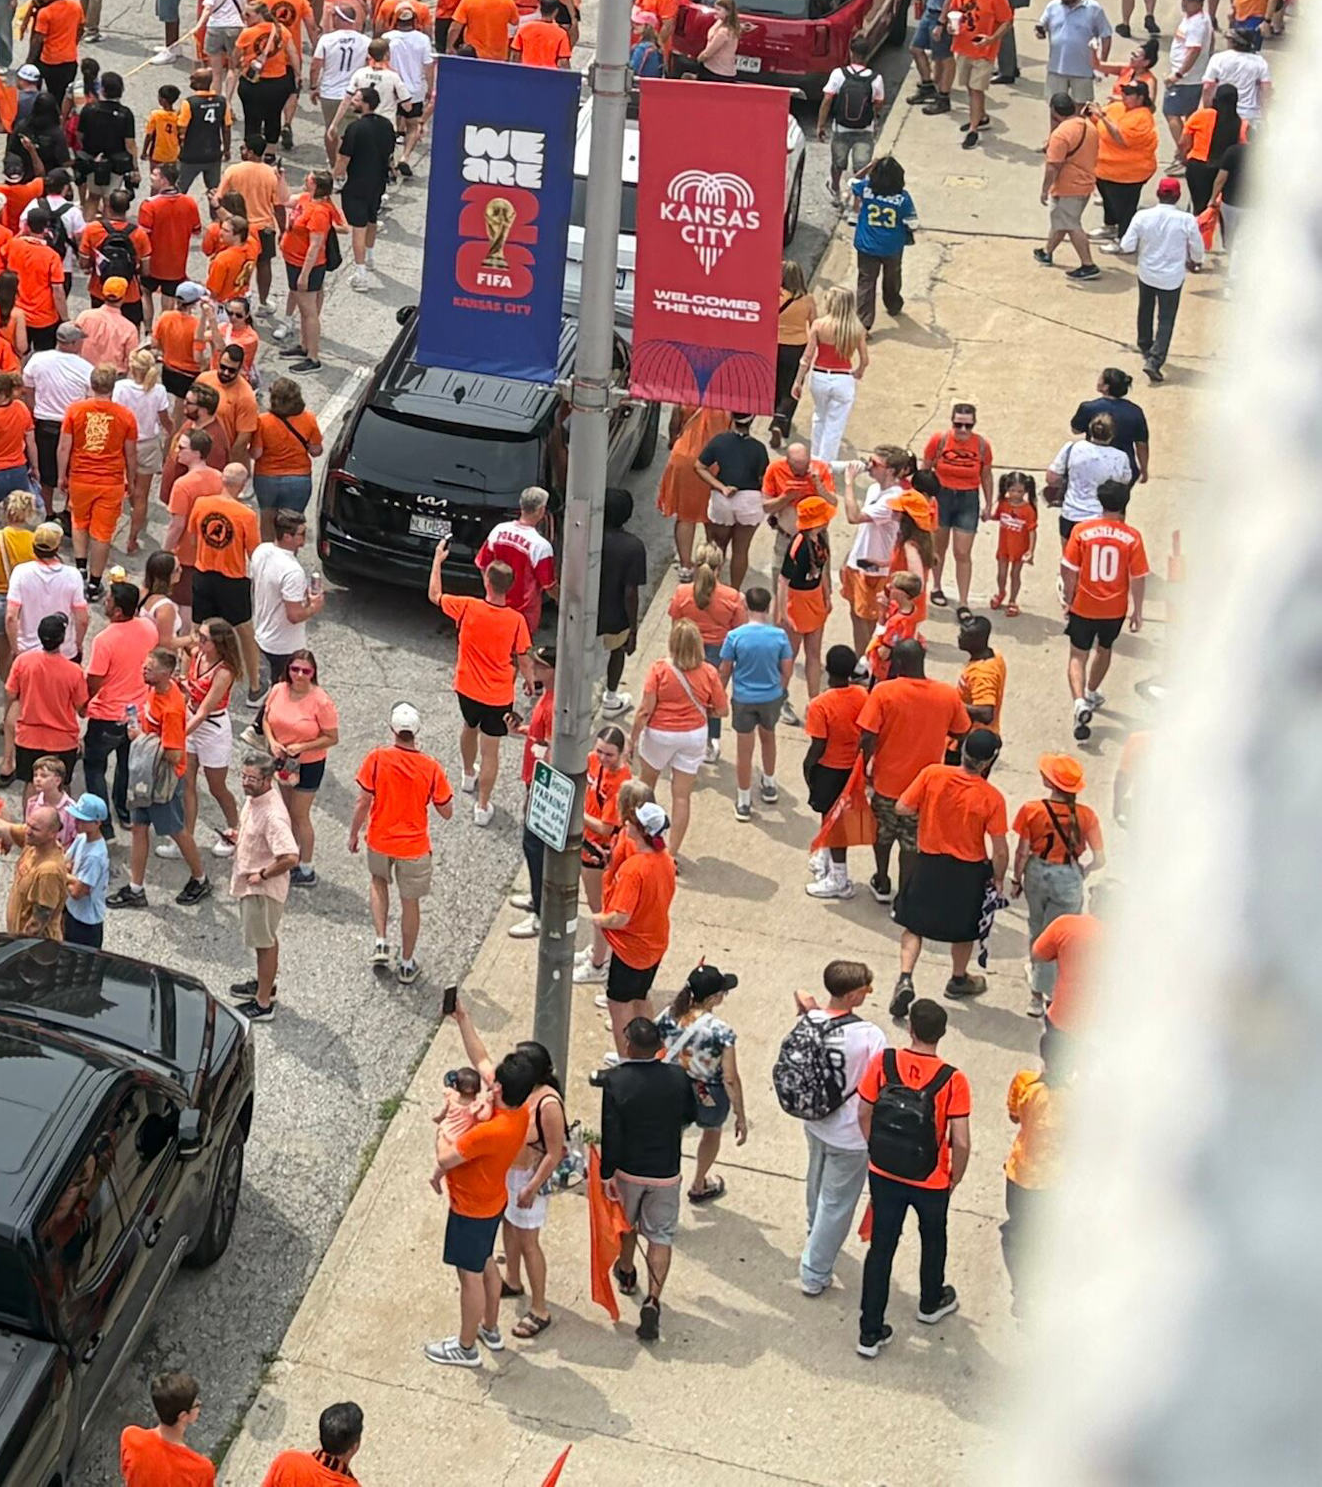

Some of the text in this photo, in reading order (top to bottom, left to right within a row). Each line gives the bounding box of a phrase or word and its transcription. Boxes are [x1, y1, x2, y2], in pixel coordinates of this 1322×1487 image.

[339, 46, 354, 72] 11
[204, 108, 217, 124] 4
[463, 124, 546, 164] WE
[461, 156, 544, 190] ARE
[659, 202, 761, 230] KANSAS
[867, 203, 897, 228] 23
[680, 225, 739, 248] CITY
[476, 272, 513, 289] FIFA
[452, 296, 533, 317] KANSAS CITY
[652, 300, 760, 322] THE WORLD
[654, 288, 762, 313] WELCOMES
[497, 530, 531, 552] POLSKA
[1089, 543, 1121, 583] 10
[538, 768, 549, 784] 3
[534, 784, 567, 815] PARKING
